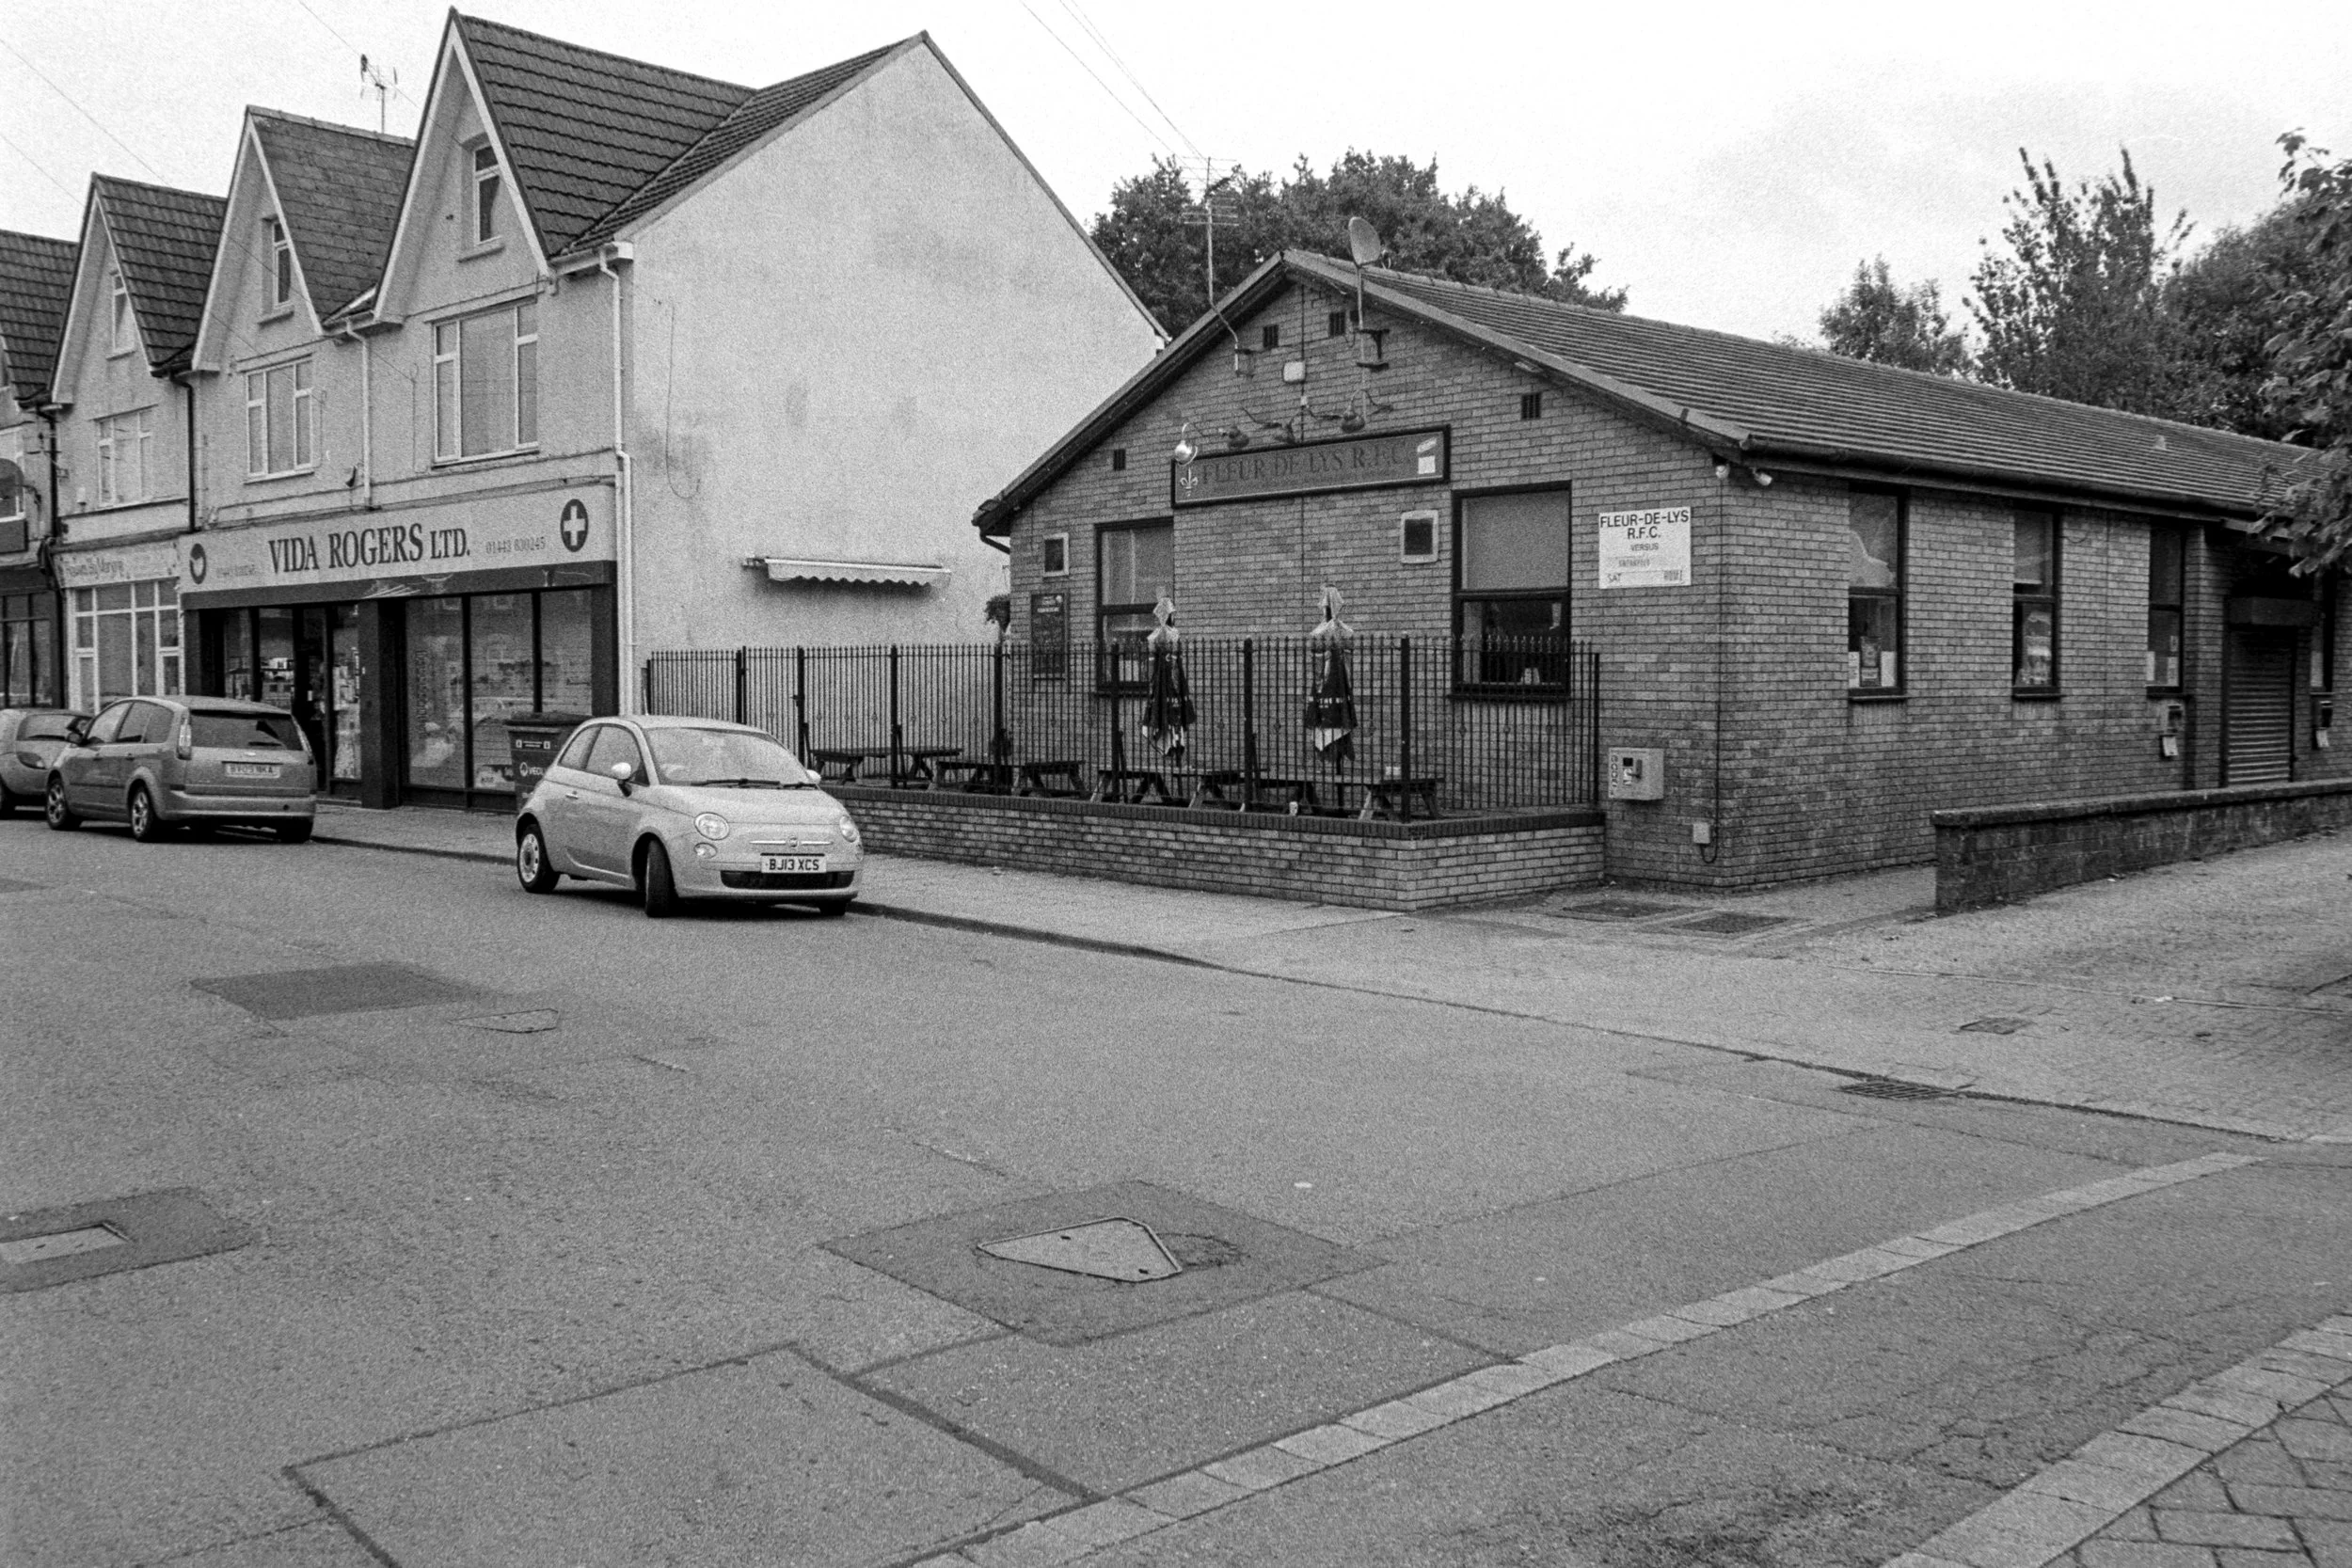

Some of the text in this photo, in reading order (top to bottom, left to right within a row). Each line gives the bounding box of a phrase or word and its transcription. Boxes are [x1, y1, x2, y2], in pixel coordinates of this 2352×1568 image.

[1600, 510, 1690, 528] FLEUR-DE-LYS
[1628, 526, 1661, 539] R.F.C.
[267, 522, 471, 575] VIDA ROGERS LTD.
[769, 858, 820, 871] BJ13 XCS
